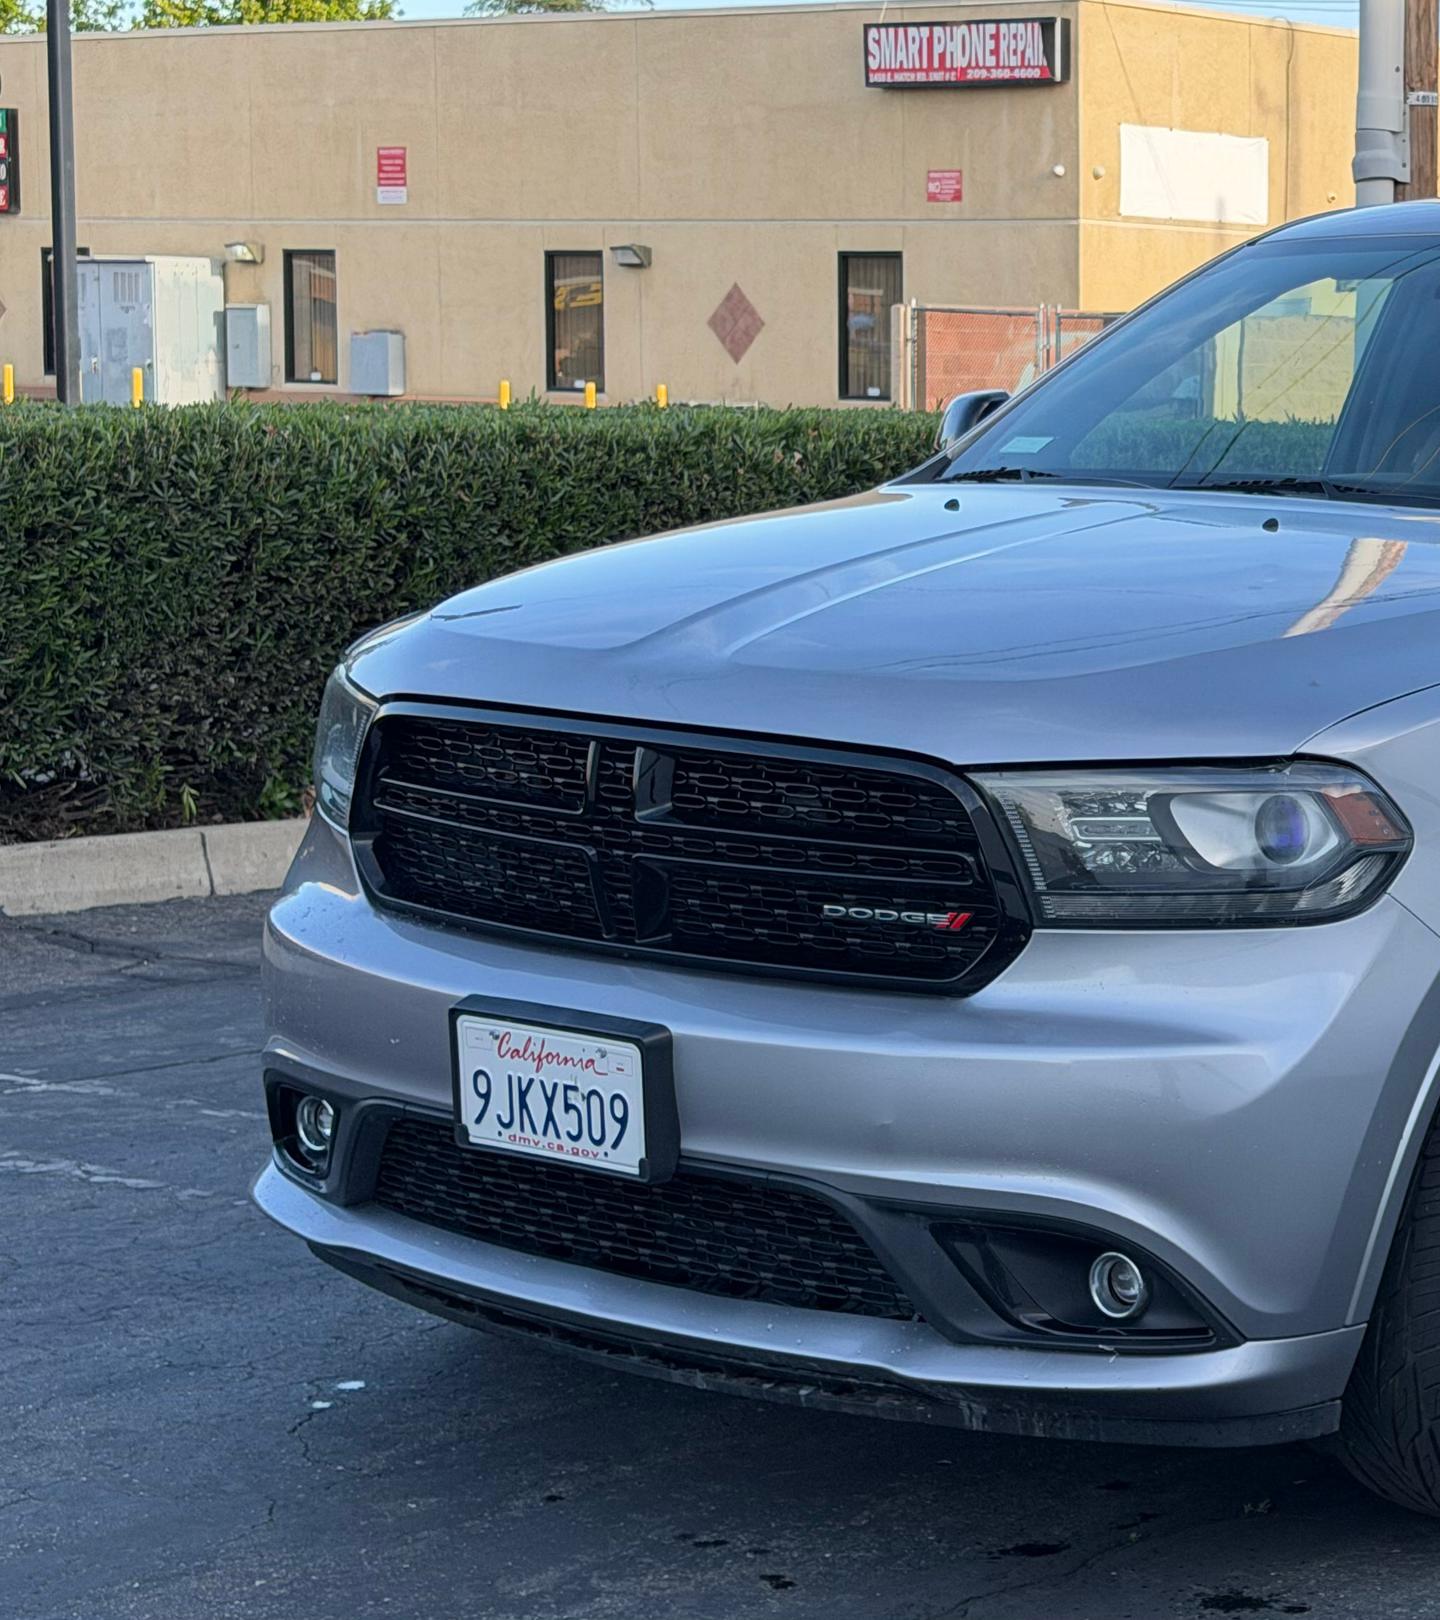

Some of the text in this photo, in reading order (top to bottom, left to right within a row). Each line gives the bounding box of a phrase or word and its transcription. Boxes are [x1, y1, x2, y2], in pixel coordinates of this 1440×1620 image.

[867, 26, 930, 70] SMART
[933, 24, 997, 68] PHONE
[823, 904, 951, 926] DODGE
[497, 1031, 608, 1076] California
[472, 1068, 630, 1150] 9JKX509
[507, 1133, 600, 1159] dmv.ca.gov
